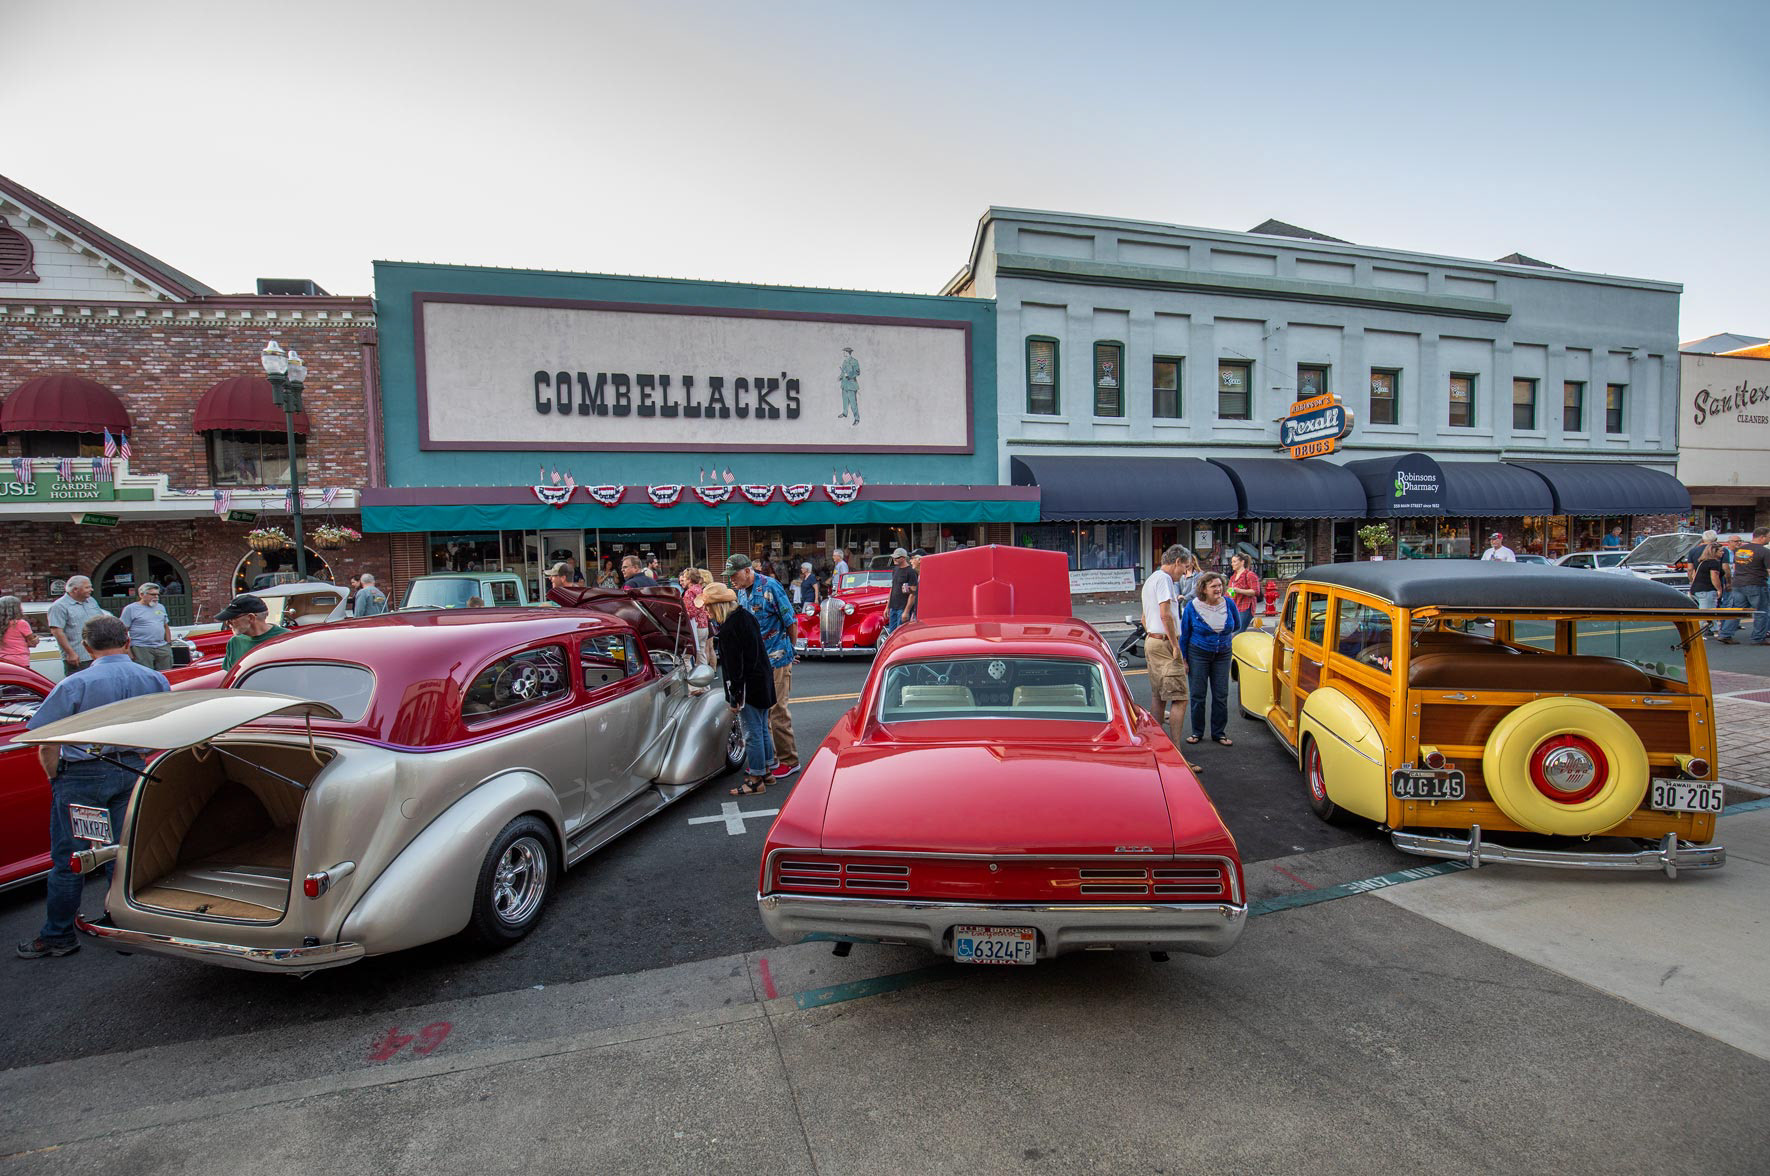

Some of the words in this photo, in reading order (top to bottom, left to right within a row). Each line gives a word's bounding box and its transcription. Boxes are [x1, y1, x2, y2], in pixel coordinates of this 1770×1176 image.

[534, 370, 800, 419] COMBELLACK'S
[1694, 380, 1769, 425] Sanitex
[1285, 408, 1338, 444] Rexall
[1737, 415, 1769, 424] CLEANERS
[1294, 441, 1330, 457] DRUGS
[1397, 471, 1436, 485] Robinsons
[50, 491, 100, 499] HOLIDAY
[1403, 481, 1439, 495] Pharmacy
[1397, 779, 1414, 795] 44
[1419, 779, 1428, 795] G
[1433, 779, 1460, 795] 145
[1400, 866, 1442, 879] MIN
[1340, 876, 1398, 894] ZONE
[974, 940, 1024, 958] 6324F
